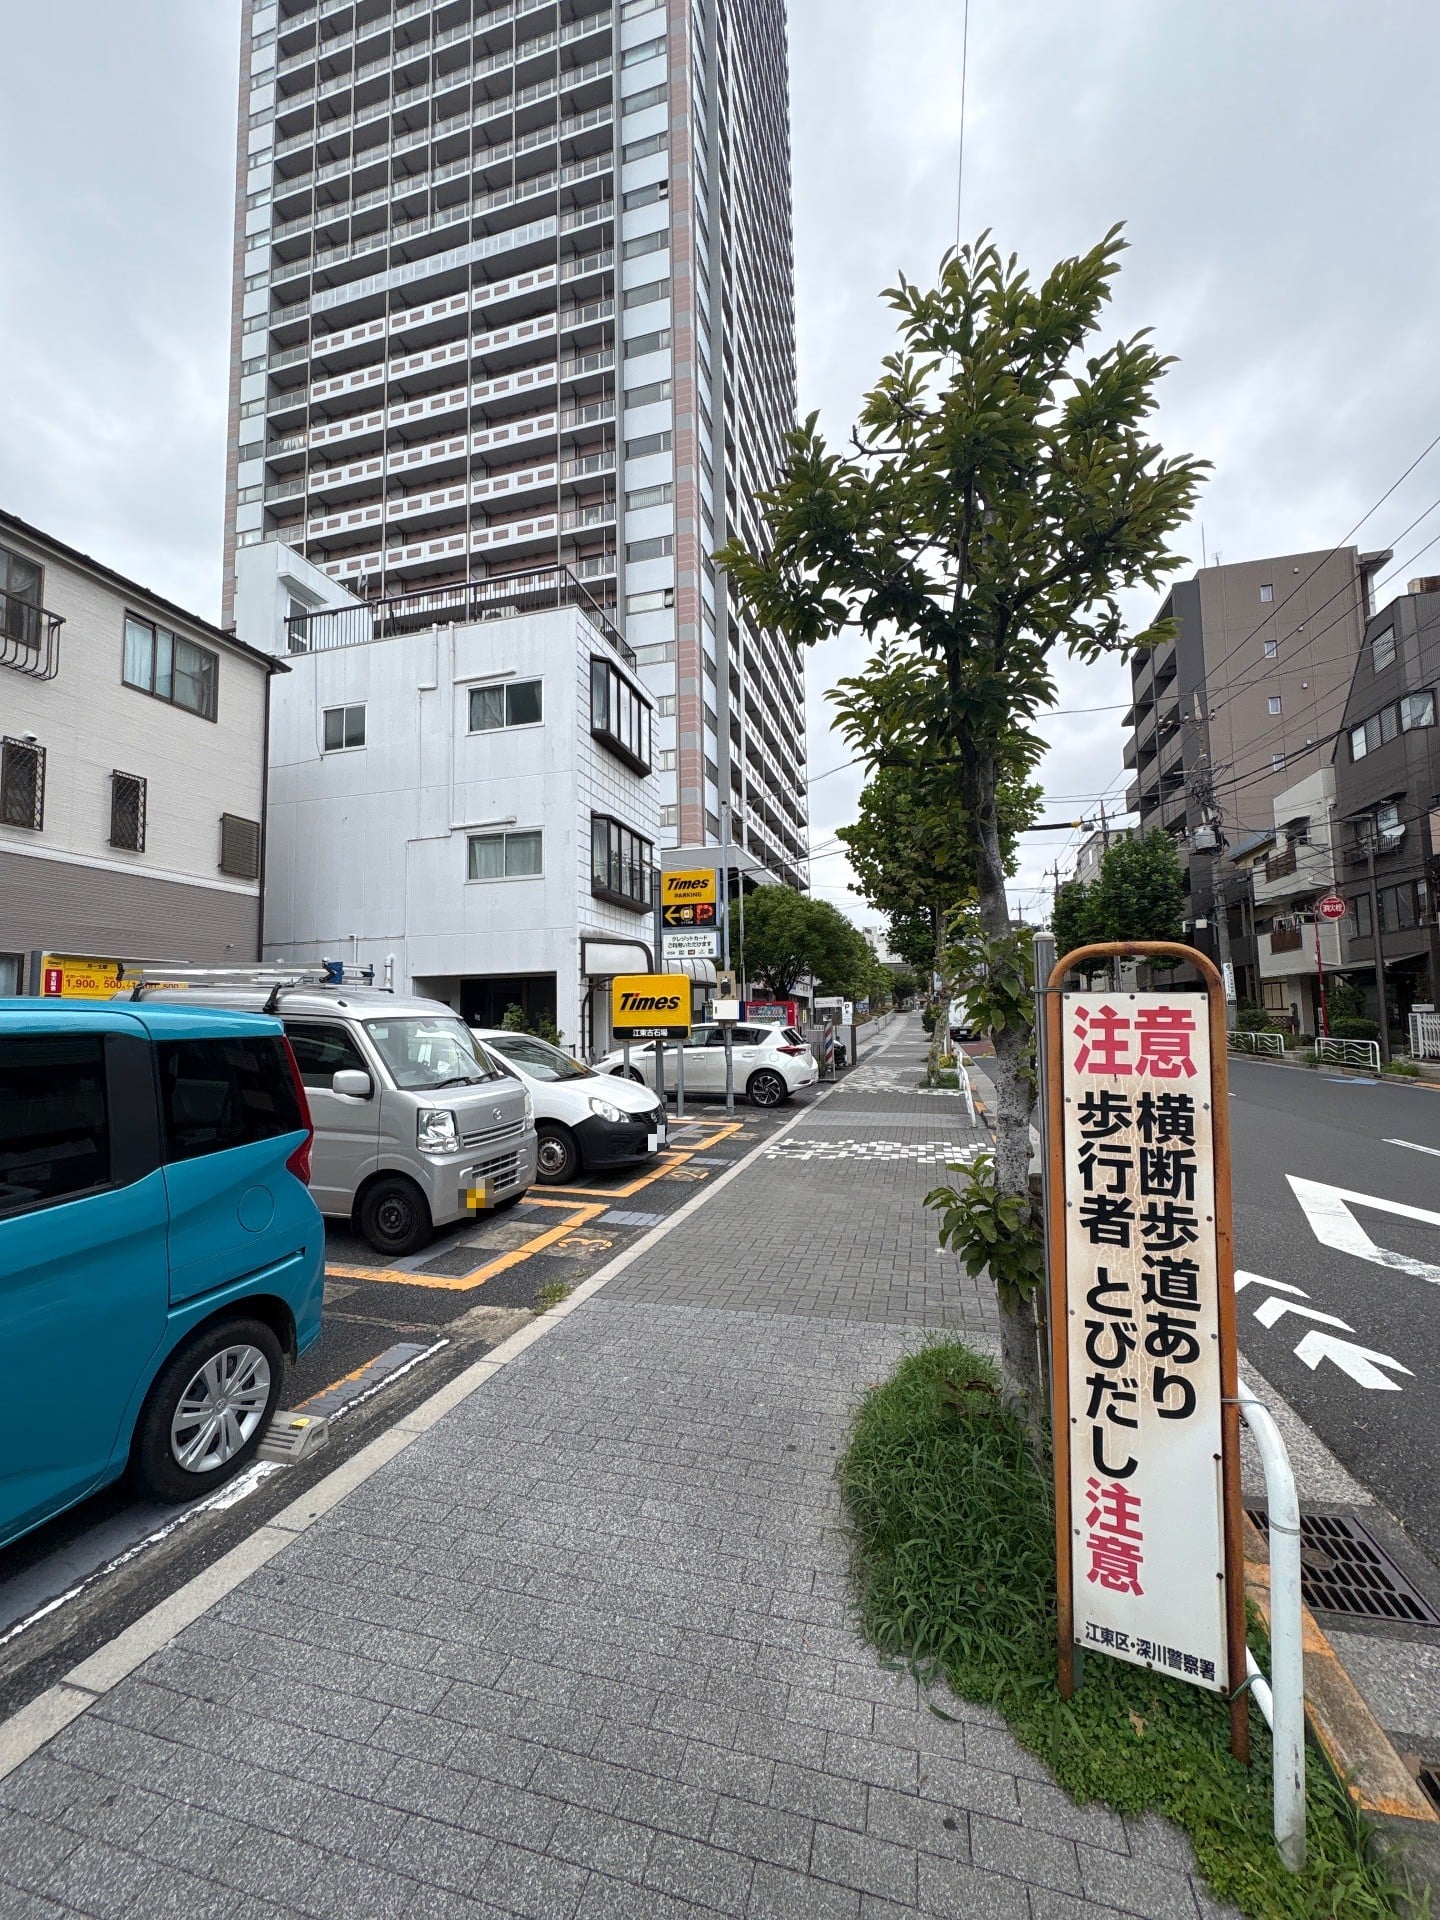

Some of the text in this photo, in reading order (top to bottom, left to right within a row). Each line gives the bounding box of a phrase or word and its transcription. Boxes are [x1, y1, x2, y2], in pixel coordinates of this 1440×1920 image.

[667, 877, 709, 891] Times
[1322, 904, 1343, 913] 消火栓
[667, 941, 712, 949] ご利用いただけます
[620, 992, 681, 1011] Times
[632, 1029, 668, 1037] 江東古石場
[1073, 1004, 1196, 1079] 注意
[1136, 1092, 1202, 1420] 横断歩道あり
[1085, 1620, 1216, 1683] 江東区・深川警察署
